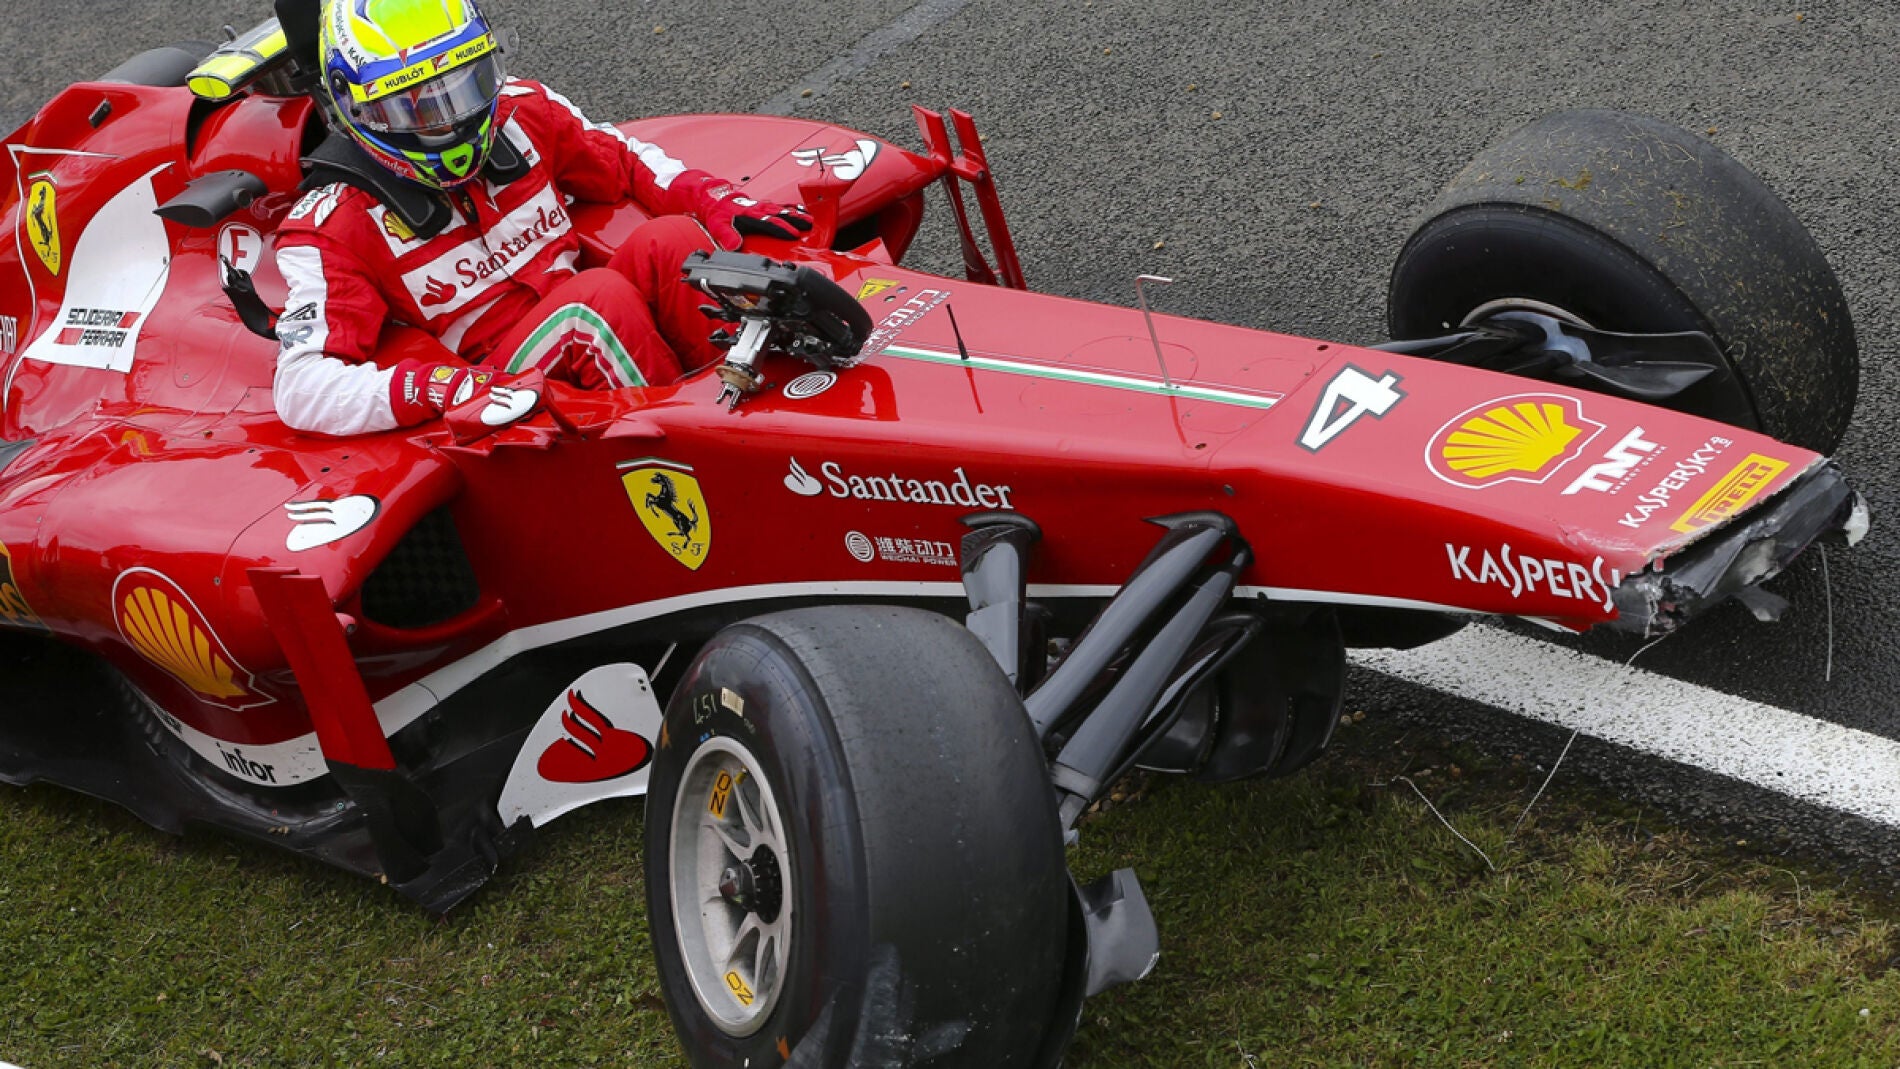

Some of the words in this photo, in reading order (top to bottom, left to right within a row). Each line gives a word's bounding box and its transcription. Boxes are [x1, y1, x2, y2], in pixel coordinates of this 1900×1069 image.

[455, 205, 566, 289] Santander
[66, 308, 123, 326] SCUDERIA
[79, 329, 127, 348] FERRARI
[1295, 362, 1407, 454] 4
[820, 460, 1014, 510] Santander
[1560, 425, 1659, 495] TNT
[1617, 441, 1722, 529] KASPERSKY
[216, 741, 277, 785] infor
